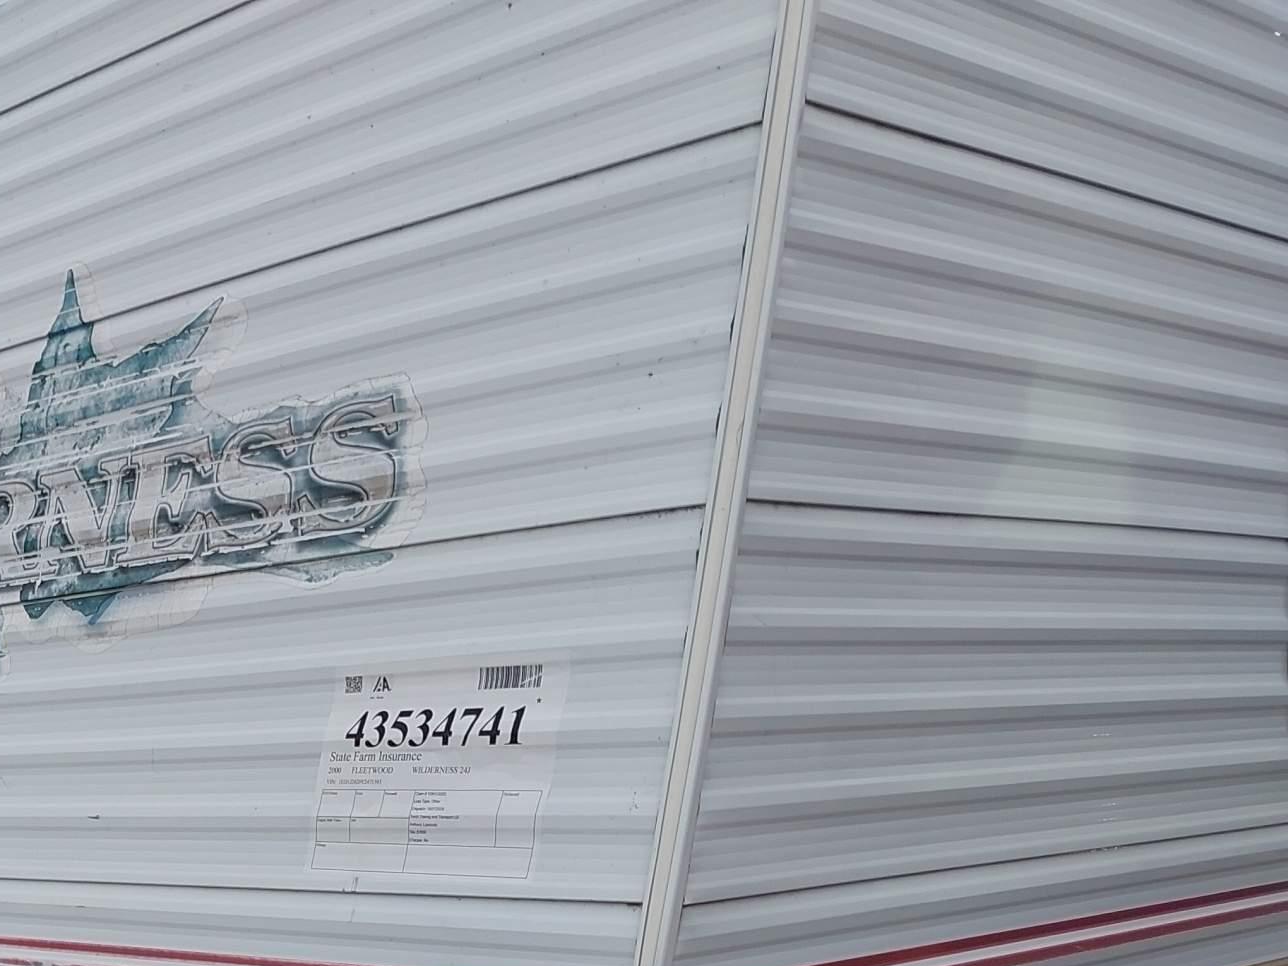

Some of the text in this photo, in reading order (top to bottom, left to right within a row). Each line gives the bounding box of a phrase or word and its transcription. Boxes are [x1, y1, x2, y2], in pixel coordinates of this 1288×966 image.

[345, 705, 527, 748] 43534741
[329, 750, 422, 762] State Farm Insurance
[351, 766, 394, 775] FLEETWOOD
[412, 765, 458, 775] WILDERNESS
